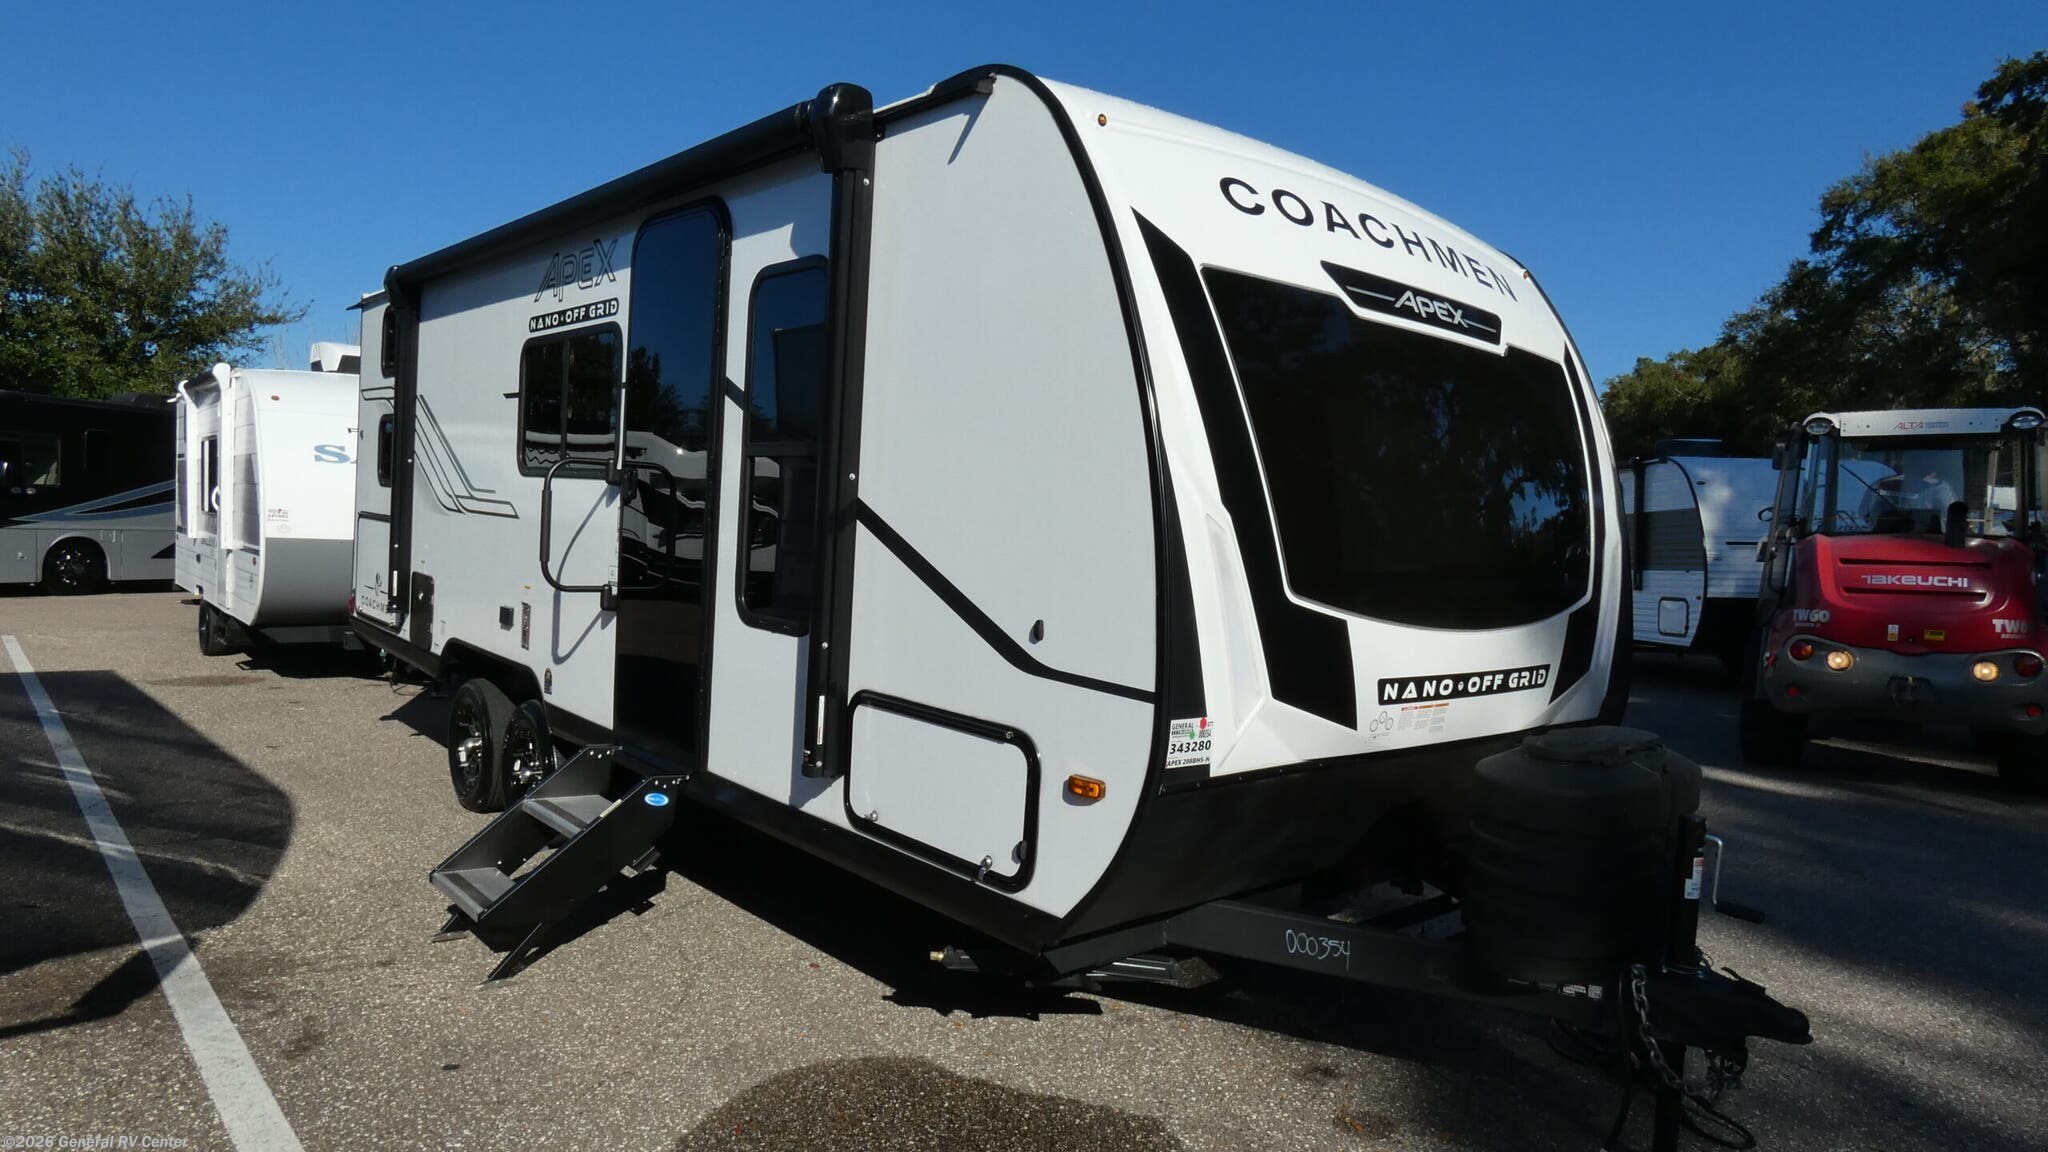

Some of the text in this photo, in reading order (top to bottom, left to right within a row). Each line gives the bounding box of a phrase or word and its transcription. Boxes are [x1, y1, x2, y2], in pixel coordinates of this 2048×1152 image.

[1220, 177, 1518, 302] COACHMEN
[534, 239, 618, 302] APEX
[530, 300, 618, 331] NANO OFF GRID
[1394, 290, 1468, 328] APEX
[1383, 668, 1546, 701] NANO OFF GRID
[1170, 740, 1211, 754] 343280
[1285, 929, 1350, 973] 000354
